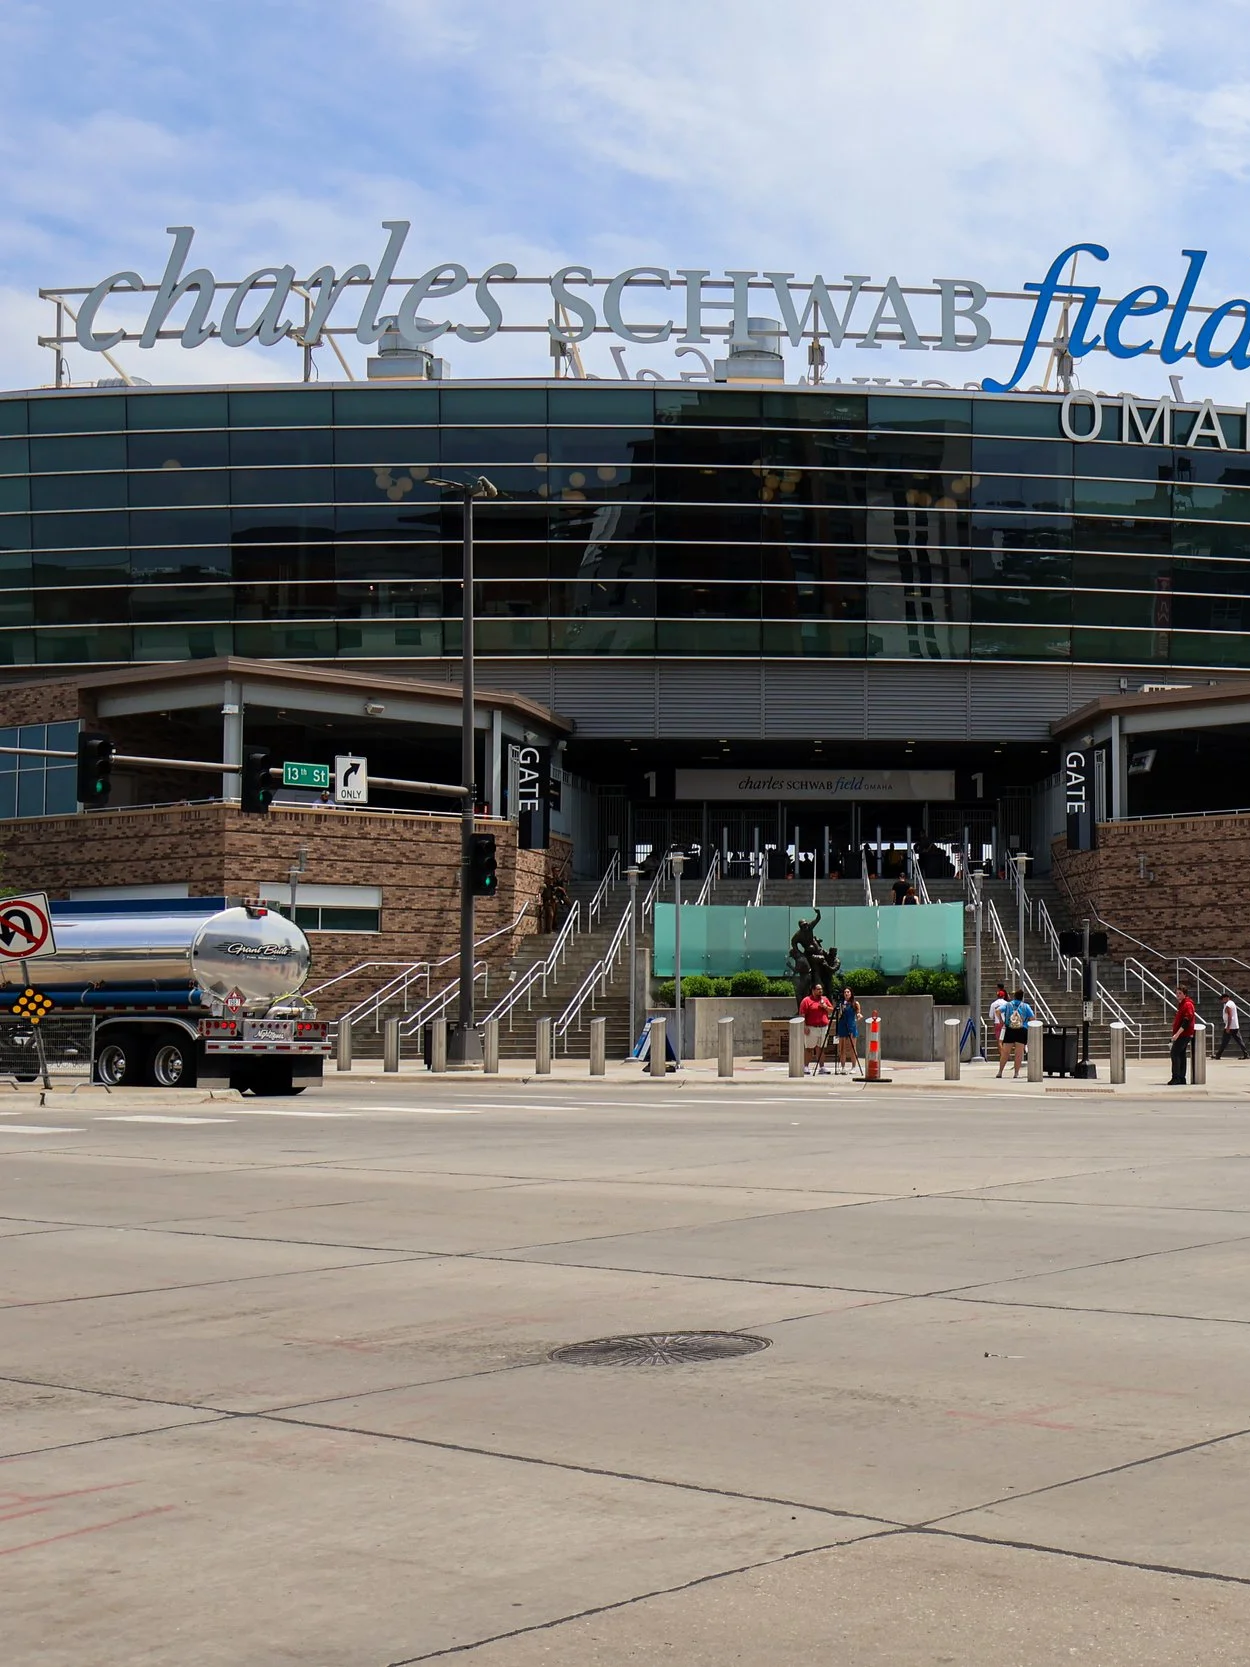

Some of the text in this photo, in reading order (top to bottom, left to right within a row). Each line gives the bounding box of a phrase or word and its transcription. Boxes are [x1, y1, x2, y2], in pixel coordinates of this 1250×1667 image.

[76, 221, 517, 351] charles
[548, 266, 992, 352] SCHWAB
[287, 767, 326, 782] 13th St
[518, 747, 540, 812] GATE
[644, 771, 656, 797] 1
[738, 776, 893, 794] charles SCHWAB field OMAHA
[971, 772, 984, 798] 1
[1066, 752, 1085, 813] GATE
[341, 789, 362, 799] ONLY
